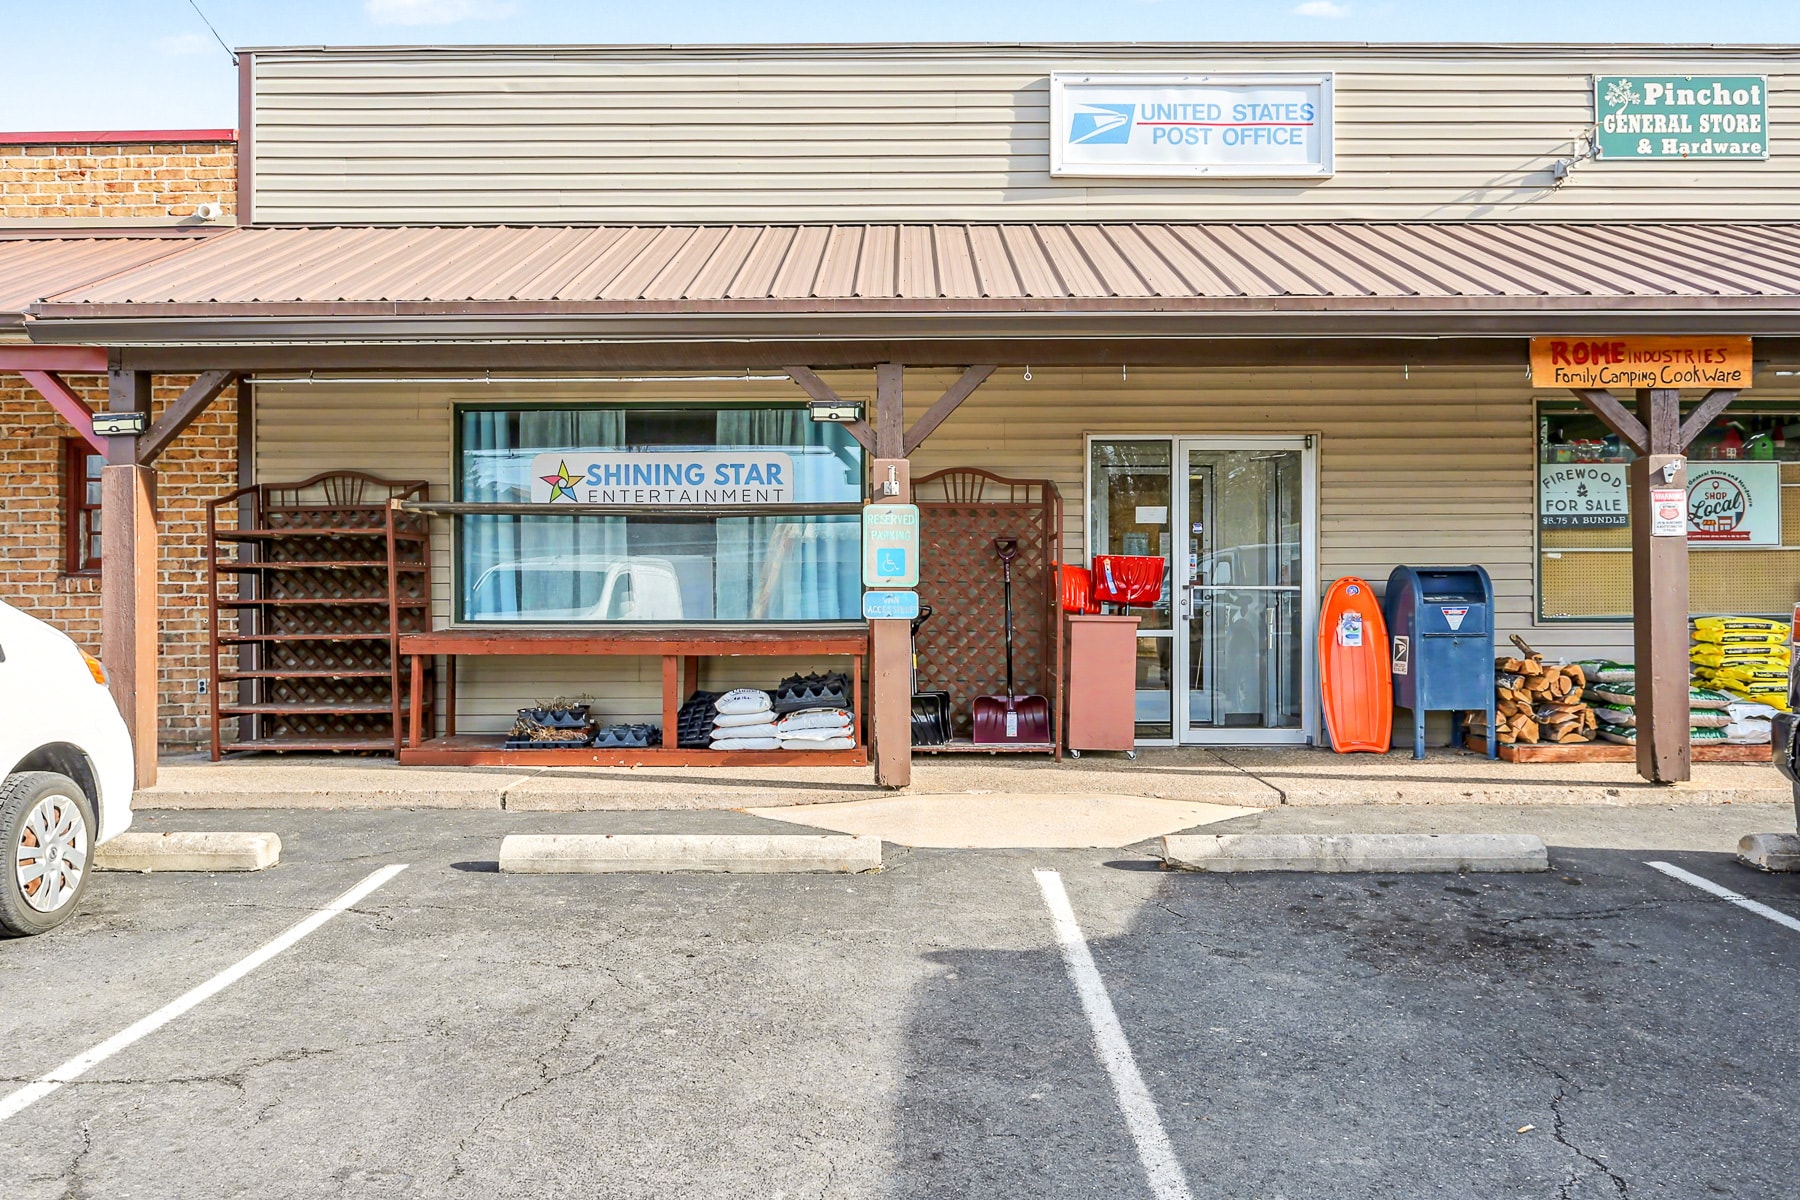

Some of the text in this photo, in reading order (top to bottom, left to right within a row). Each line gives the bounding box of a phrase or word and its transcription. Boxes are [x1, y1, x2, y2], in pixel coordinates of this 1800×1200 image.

[1643, 82, 1761, 106] Pinchot
[1141, 103, 1314, 121] UNITED STATES
[1603, 114, 1761, 133] GENERAL STORE
[1152, 127, 1303, 146] POST OFFICE
[1637, 138, 1762, 154] & Hardware
[1551, 341, 1727, 366] ROME INDUSTRIES
[1555, 367, 1597, 387] Family
[1599, 366, 1656, 388] Camping
[586, 463, 784, 486] SHINING STAR
[1542, 468, 1622, 489] FIREWOOD
[588, 488, 784, 503] ENTERTAINMENT
[1704, 491, 1728, 500] SHOP
[1546, 499, 1622, 512] FOR SALE
[1687, 490, 1742, 521] Local
[867, 514, 915, 526] RESERVED
[1571, 516, 1579, 524] A
[1582, 516, 1626, 524] BUNDLE
[870, 530, 912, 541] PARKING
